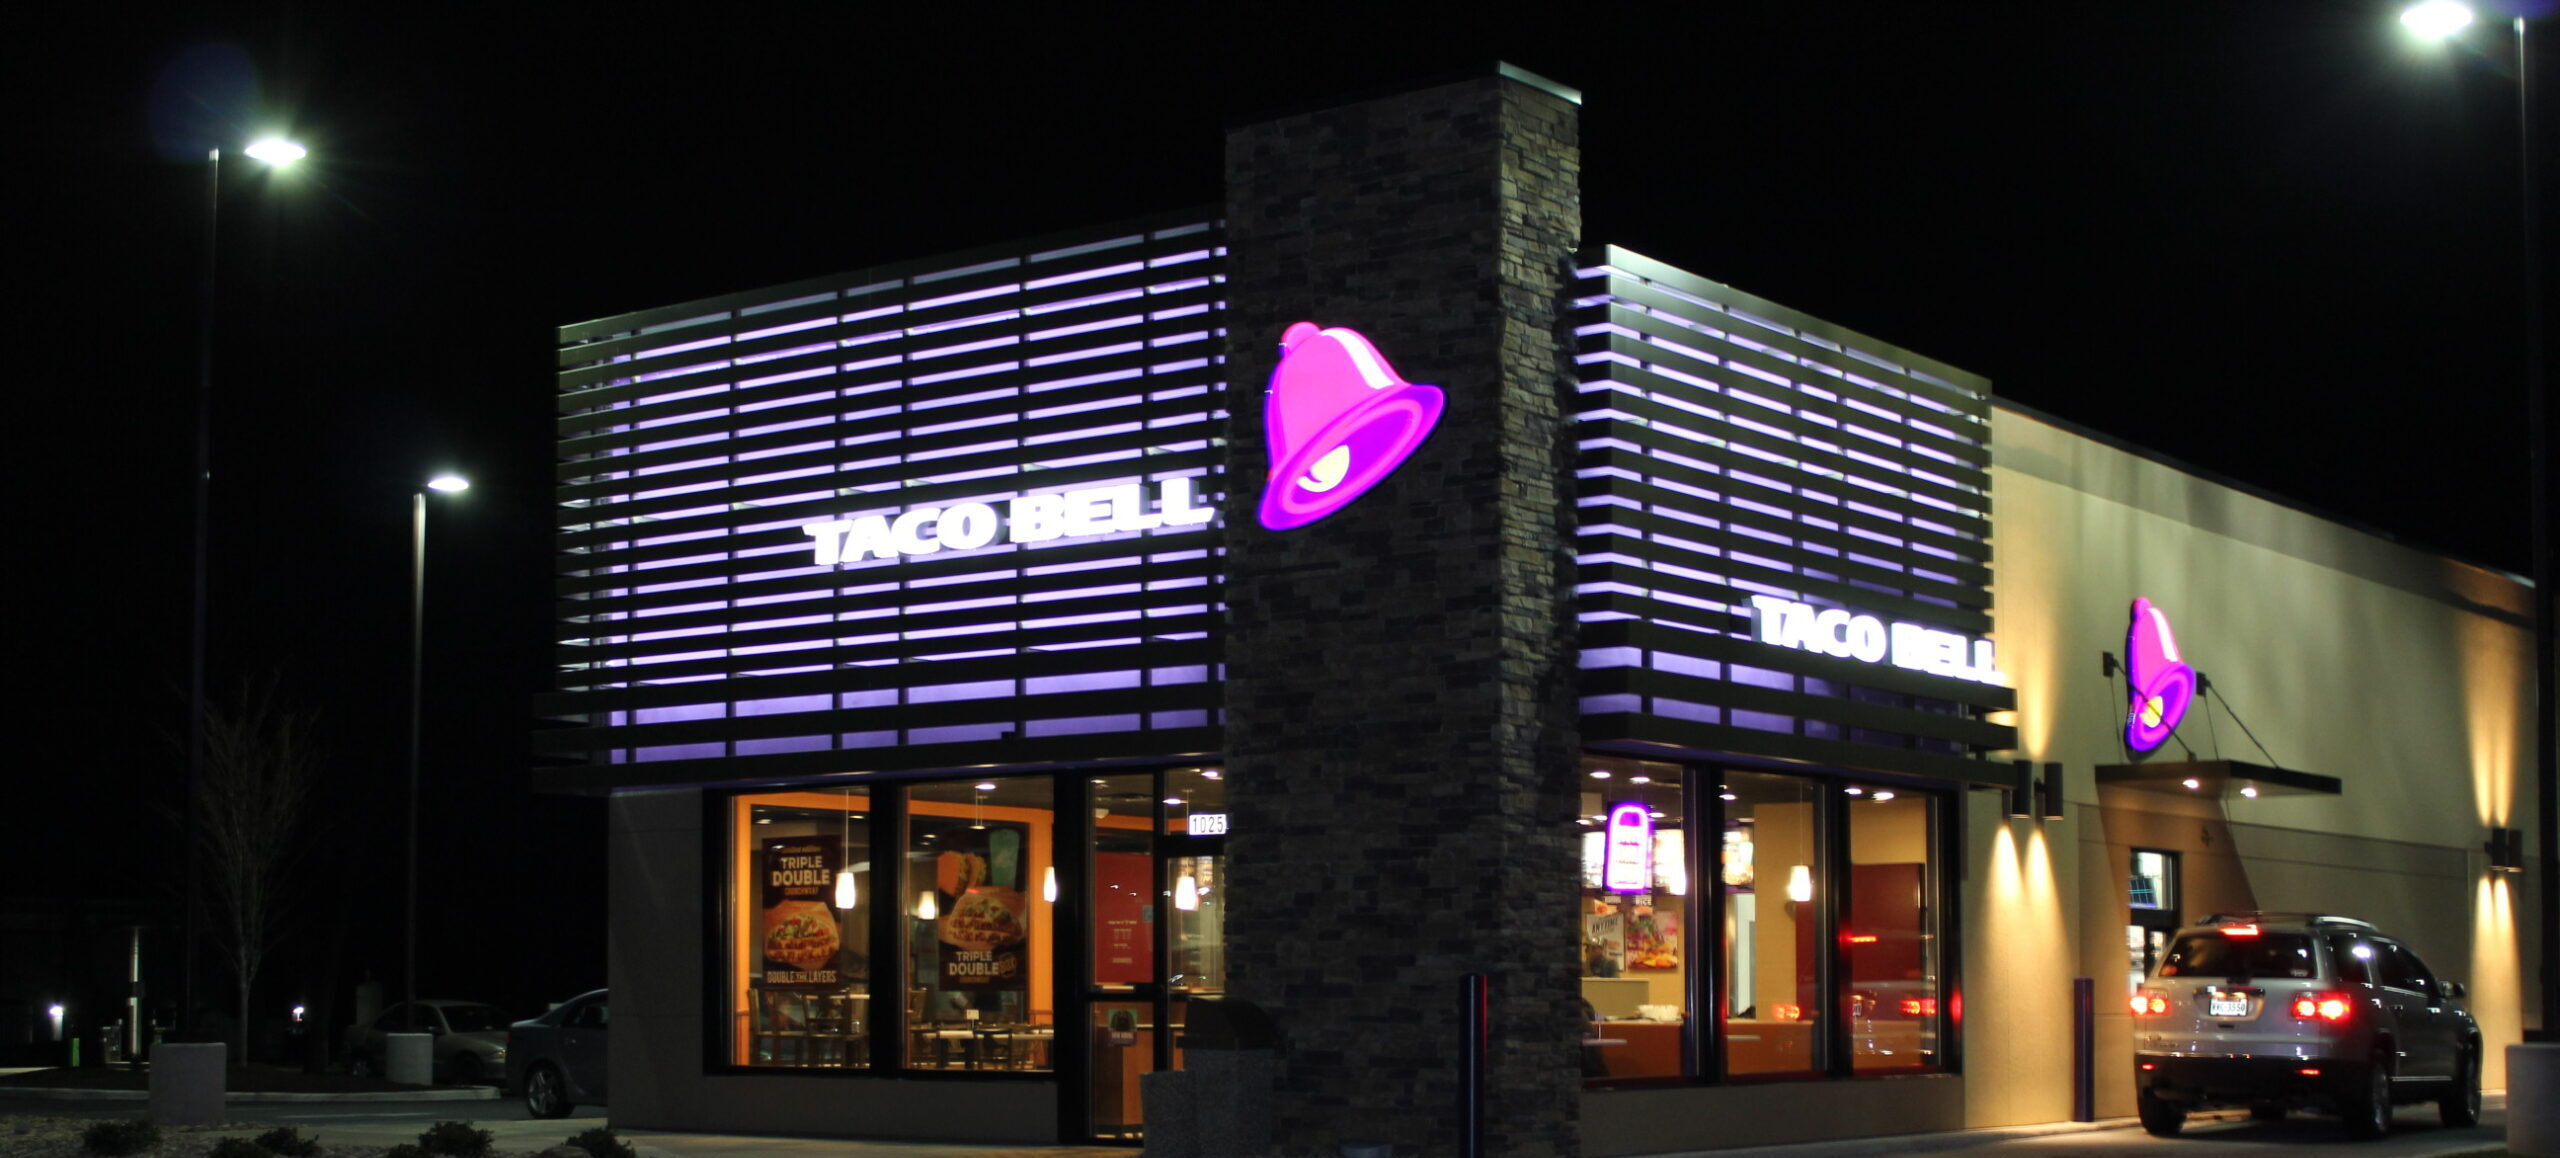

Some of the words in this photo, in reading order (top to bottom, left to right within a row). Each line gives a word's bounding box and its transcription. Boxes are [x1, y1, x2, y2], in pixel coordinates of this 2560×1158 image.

[802, 501, 1000, 566] TACO
[1009, 476, 1216, 544] BELL
[1750, 594, 1887, 663] TACO
[1891, 621, 2007, 687] BELL
[1193, 816, 1224, 833] 1025
[781, 855, 823, 869] TRIPLE
[772, 868, 831, 887] DOUBLE
[955, 951, 993, 962] TRIPLE
[949, 962, 999, 976] DOUBLE
[767, 970, 794, 984] DOUBLE
[808, 970, 838, 984] LAYERS
